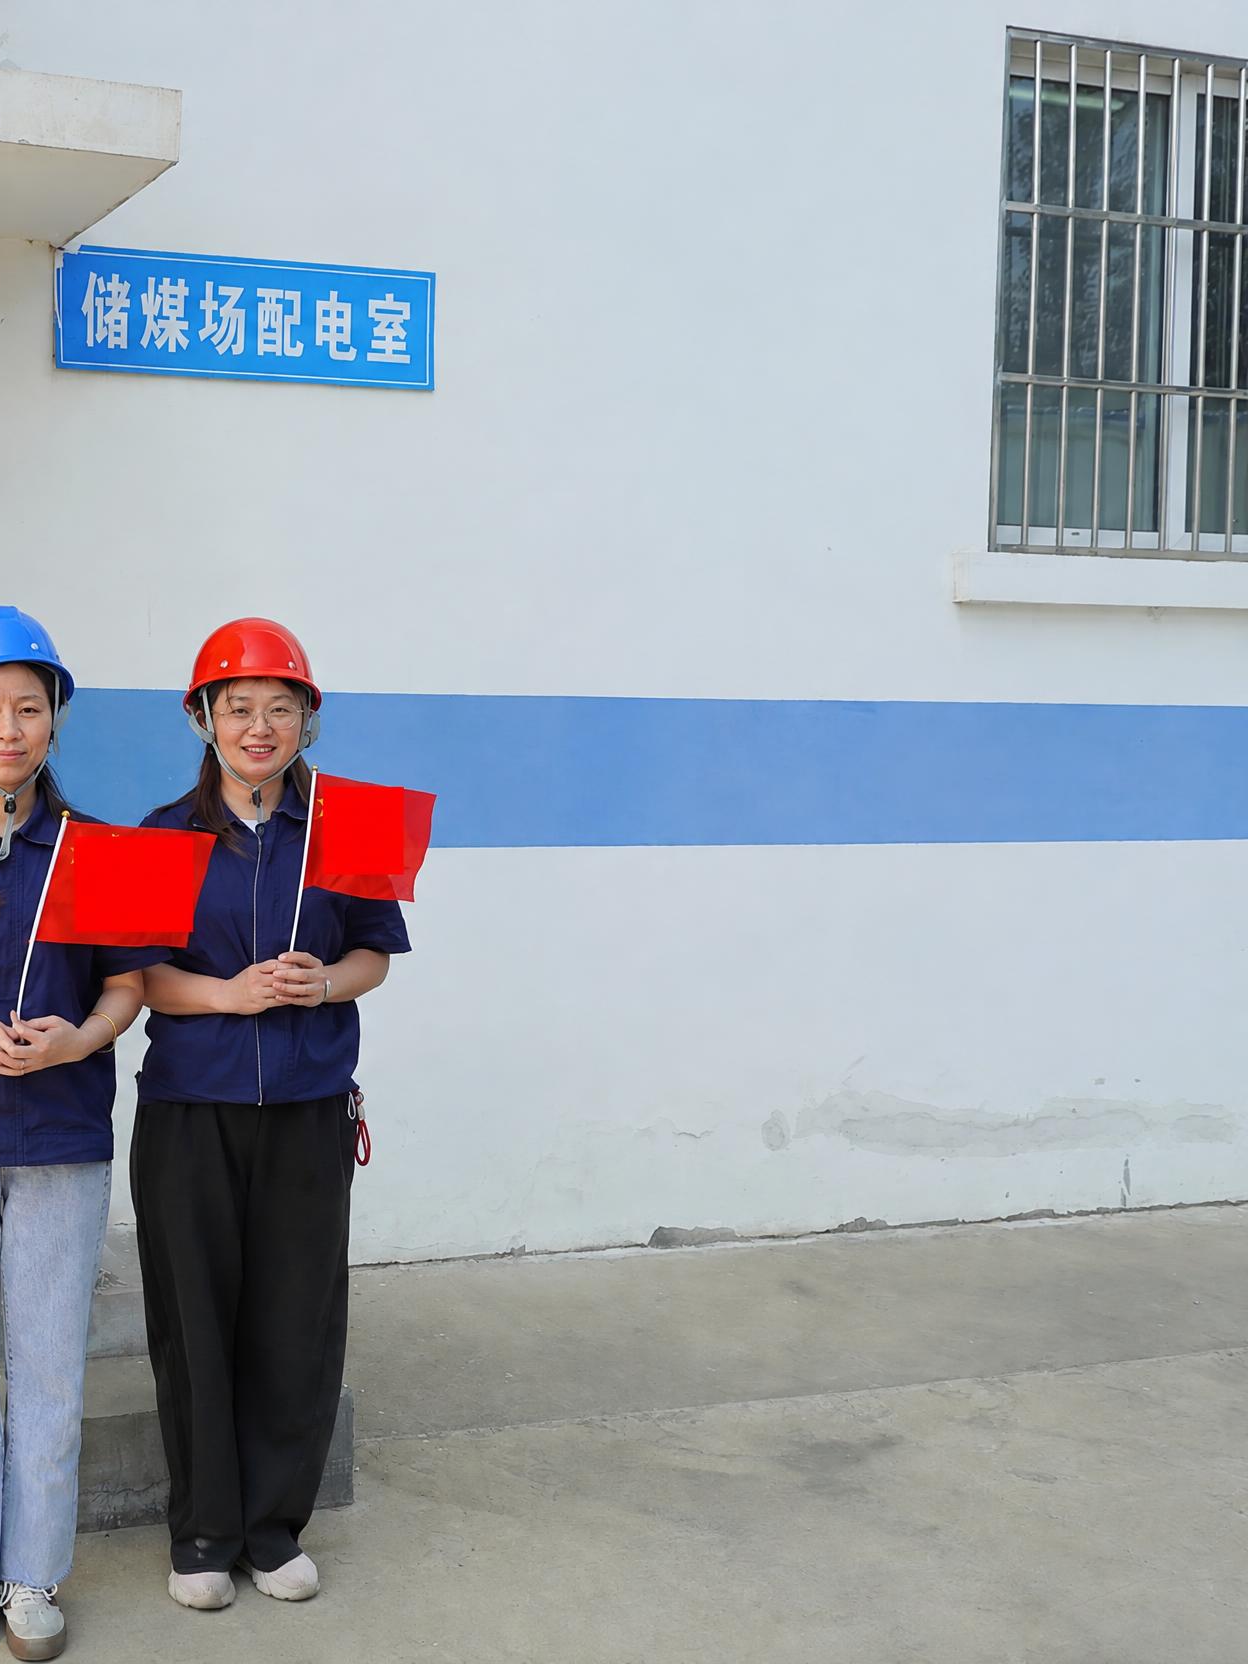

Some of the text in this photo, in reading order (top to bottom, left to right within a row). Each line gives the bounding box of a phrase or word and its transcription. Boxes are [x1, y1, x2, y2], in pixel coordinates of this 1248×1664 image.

[81, 271, 412, 365] 储煤场配电室
